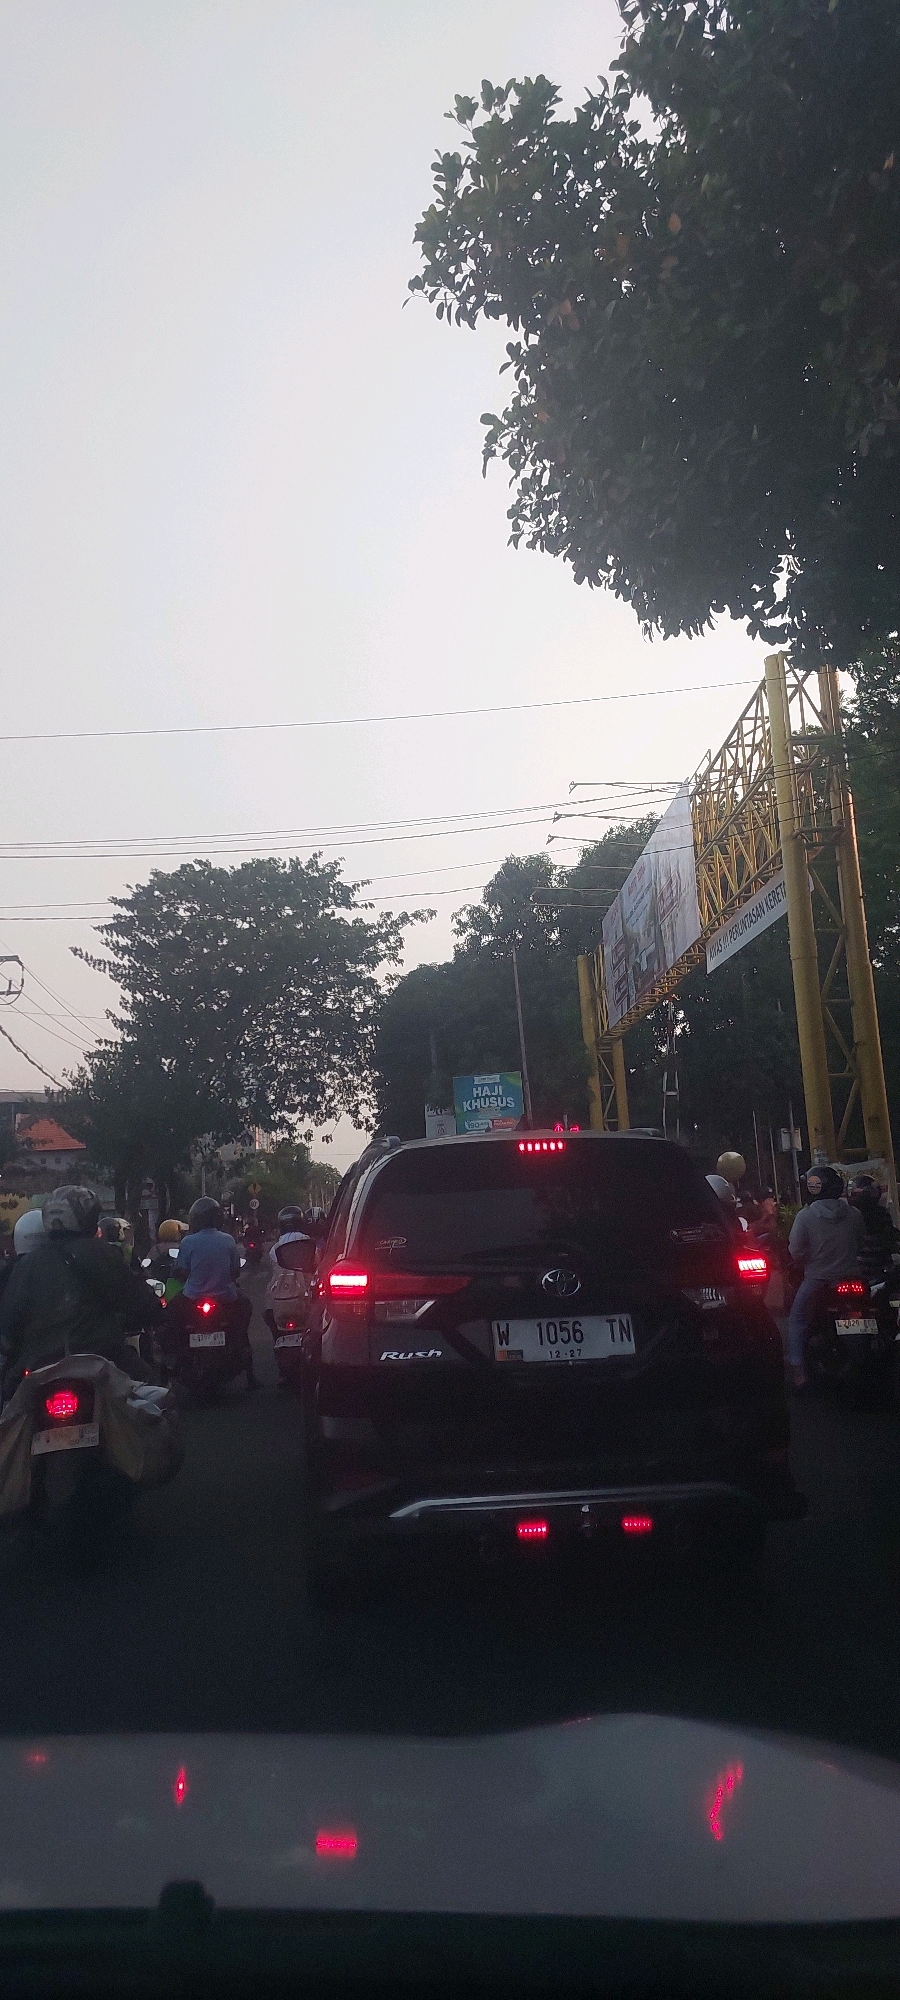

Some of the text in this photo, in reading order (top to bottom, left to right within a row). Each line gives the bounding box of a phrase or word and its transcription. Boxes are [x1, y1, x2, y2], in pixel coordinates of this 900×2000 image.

[473, 1086, 503, 1097] HAJI
[463, 1097, 515, 1112] KHUSUS
[496, 1318, 632, 1346] W 1056 TN
[380, 1349, 442, 1361] Rush
